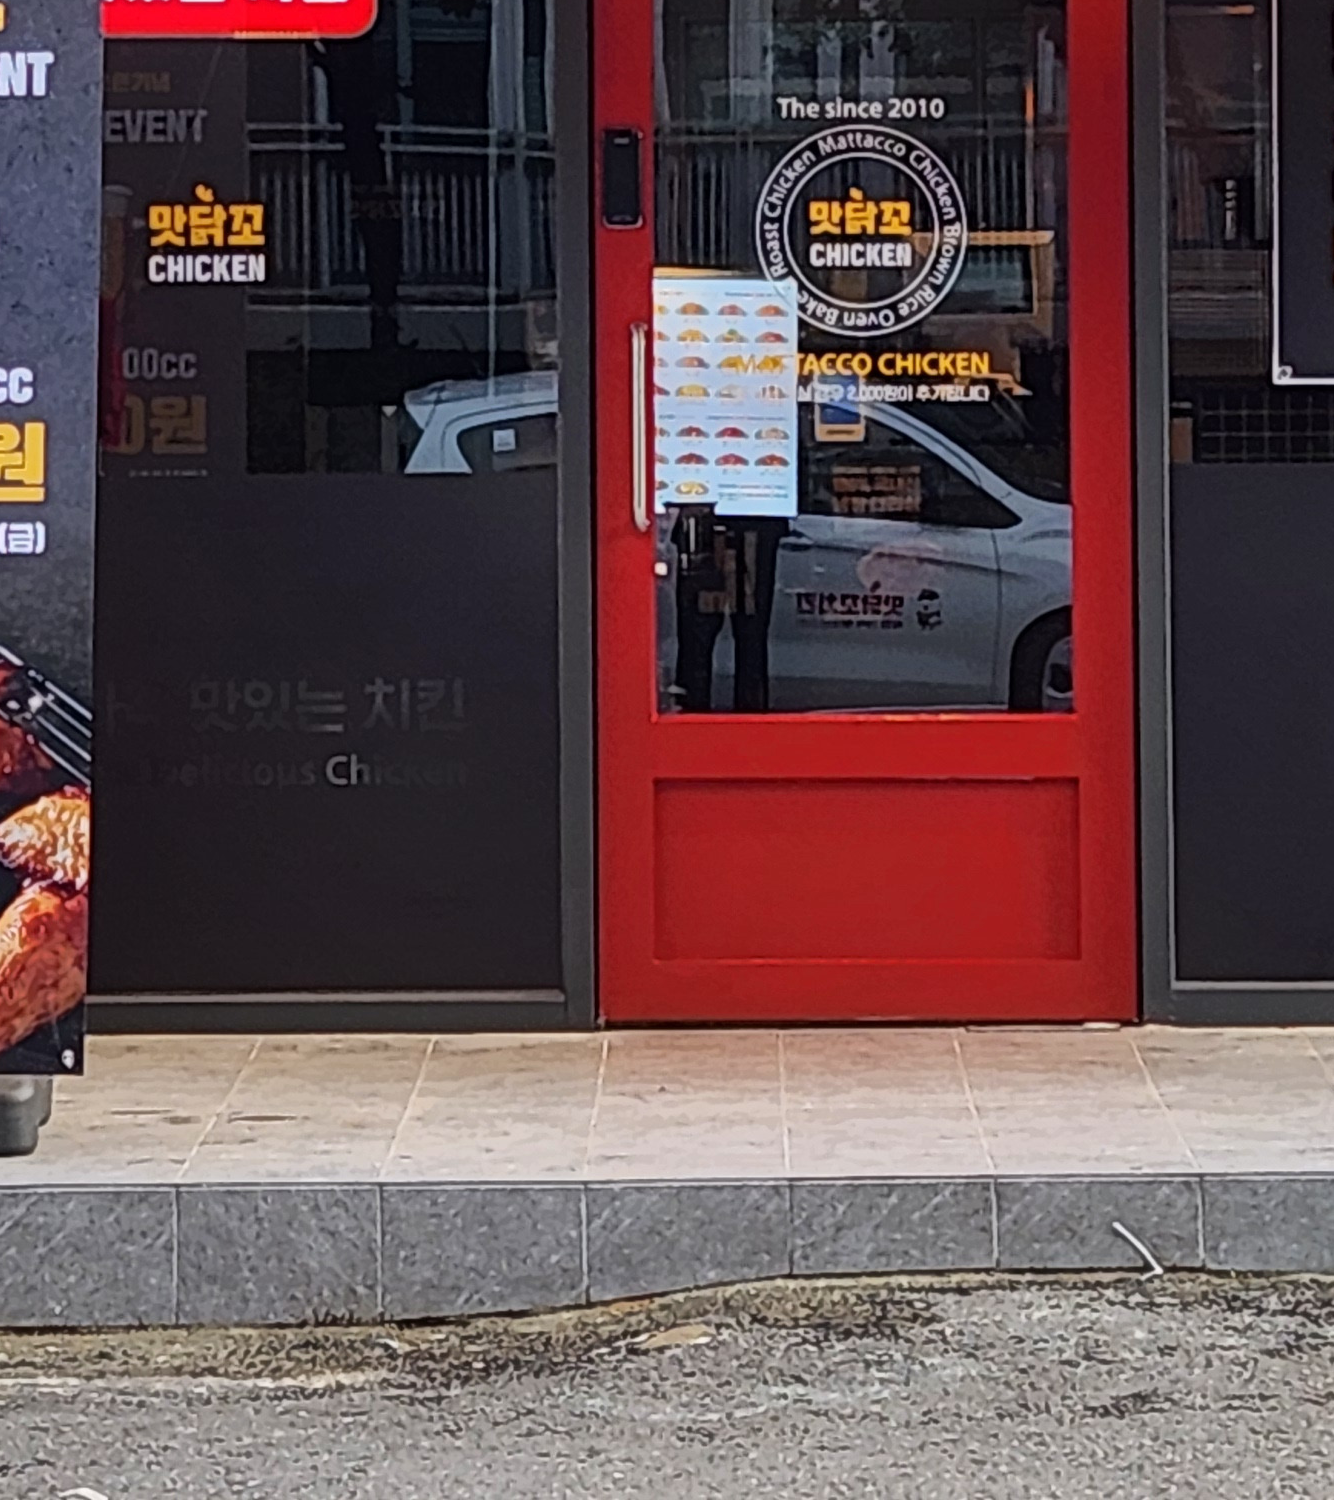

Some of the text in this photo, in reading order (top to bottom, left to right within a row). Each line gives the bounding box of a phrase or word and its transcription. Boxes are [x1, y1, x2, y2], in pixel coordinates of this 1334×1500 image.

[775, 96, 946, 119] The since 2010
[148, 202, 266, 248] 맛닭꼬
[763, 131, 962, 328] Roast Chicken Mattacco Chicken Brown Rice Oven Bake
[809, 200, 912, 236] 맛닭꼬
[147, 254, 266, 283] CHICKEN
[809, 242, 913, 268] CHICKEN
[877, 351, 990, 376] CHICKEN
